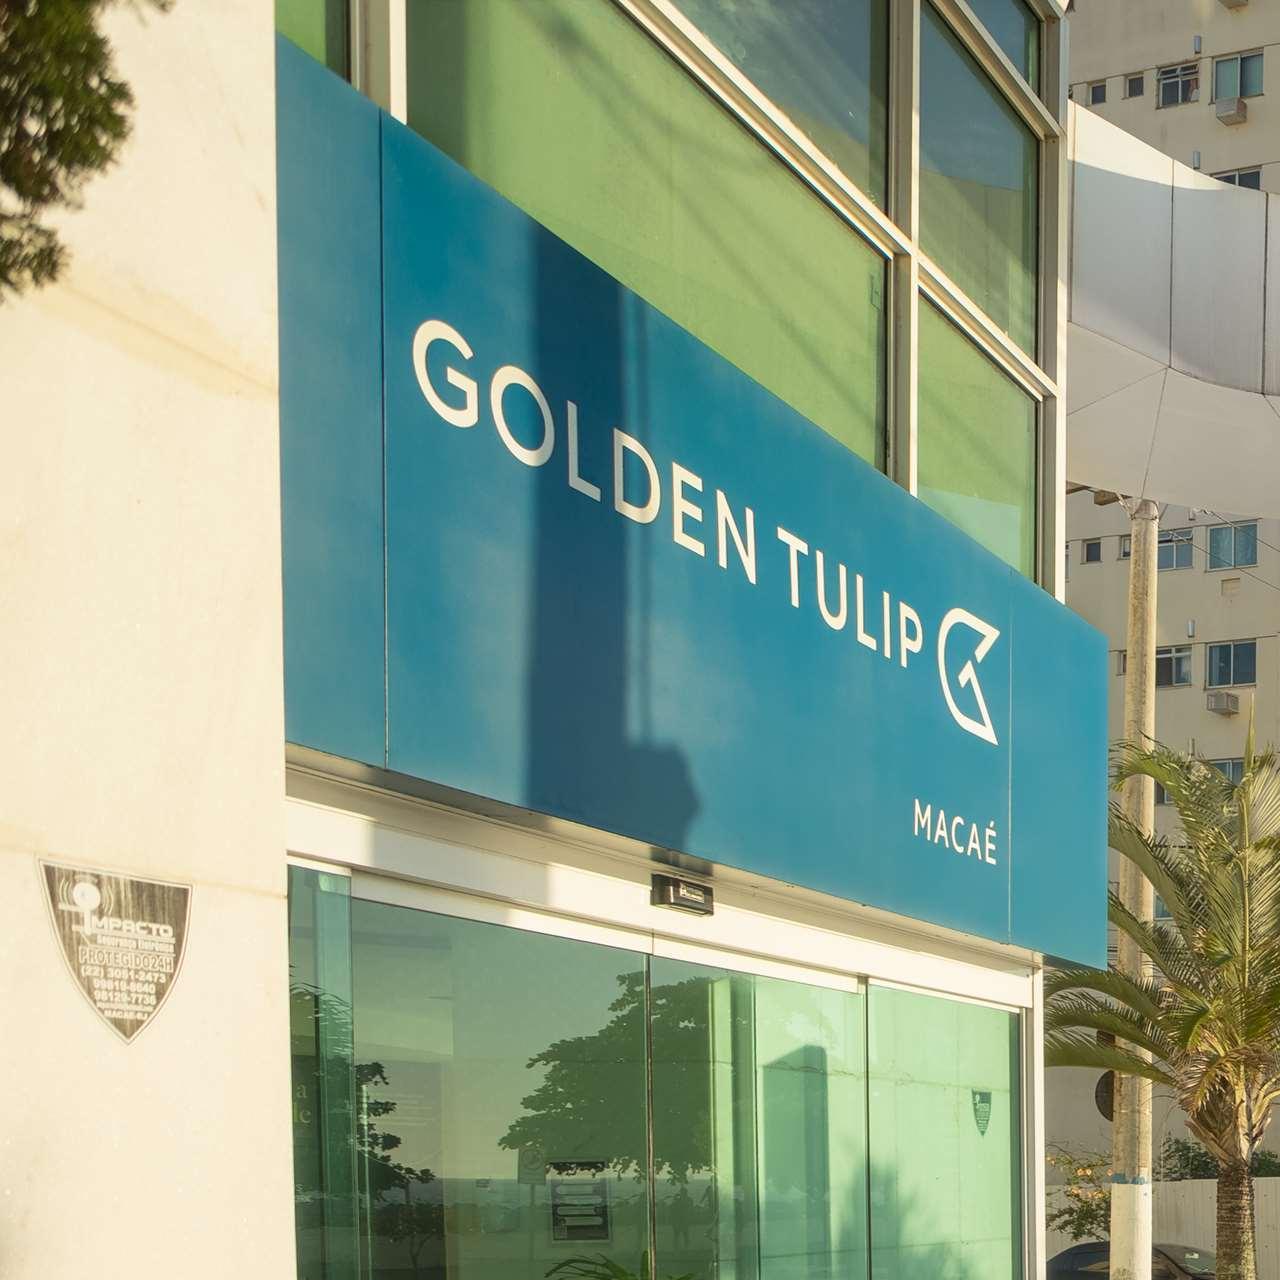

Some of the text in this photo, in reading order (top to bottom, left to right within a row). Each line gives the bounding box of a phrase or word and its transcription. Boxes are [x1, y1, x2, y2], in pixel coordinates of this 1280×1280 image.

[412, 319, 925, 669] GOLDEN TULIP
[913, 798, 999, 866] MACAÉ
